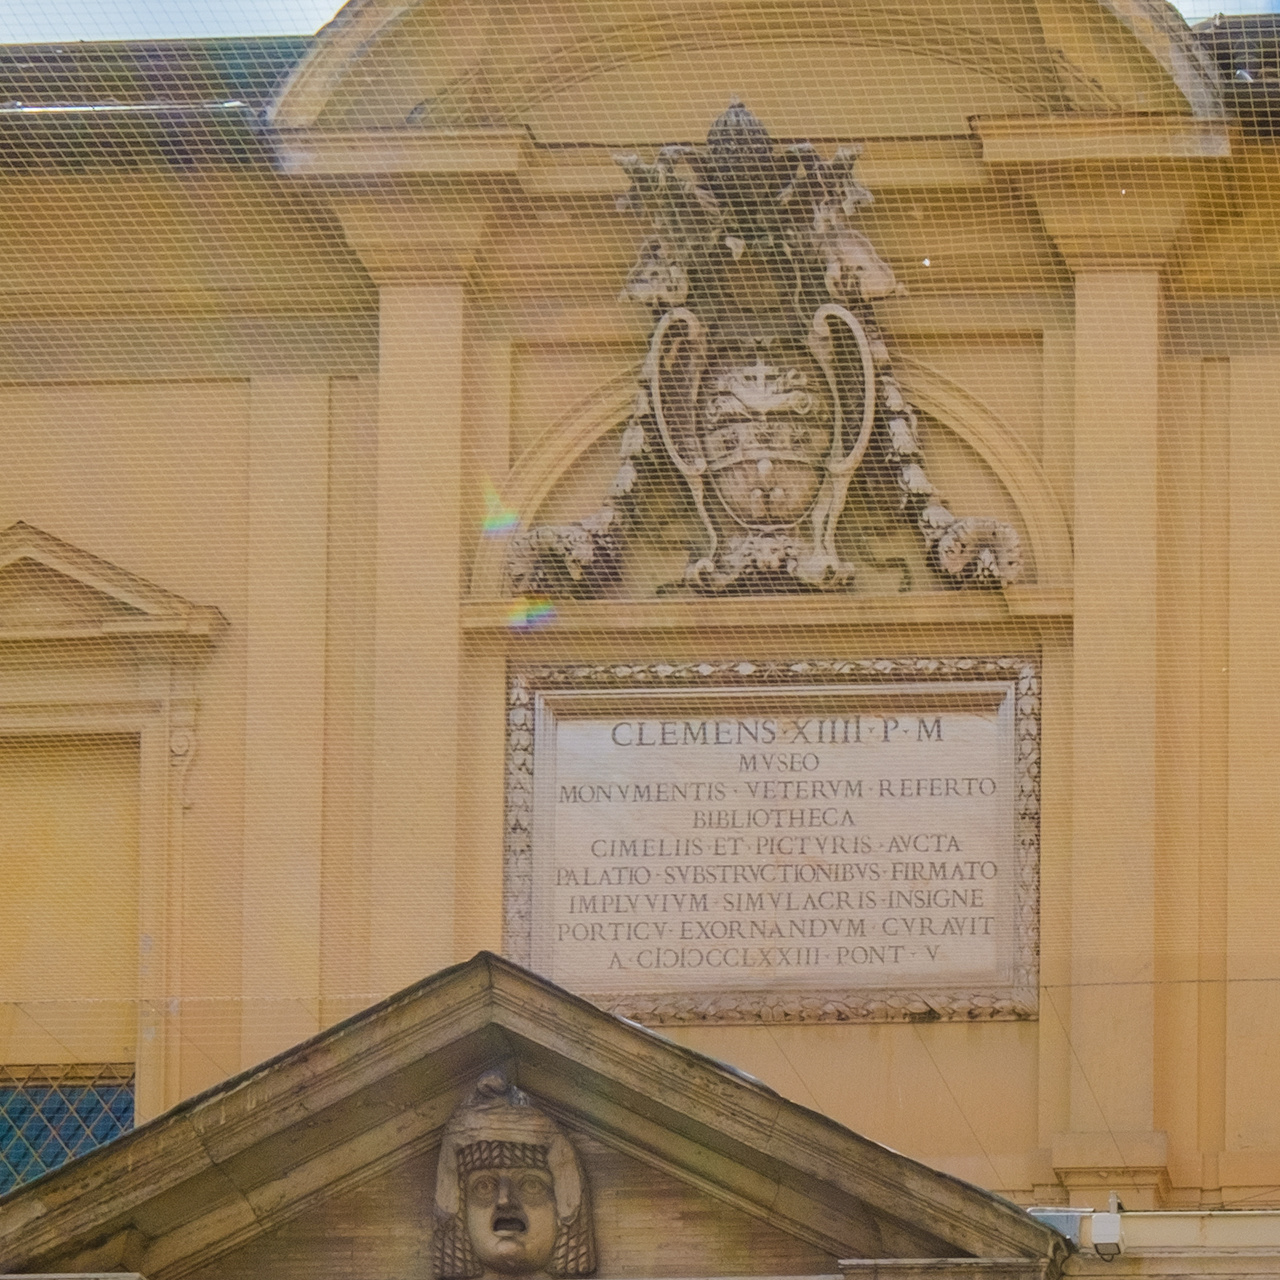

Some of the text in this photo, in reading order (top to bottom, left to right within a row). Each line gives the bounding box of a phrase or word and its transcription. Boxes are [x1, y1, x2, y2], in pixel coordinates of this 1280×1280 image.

[611, 715, 944, 747] CLEMENS XIIII P M
[738, 752, 820, 773] MVSEO
[558, 776, 998, 804] MONVMENTIS VETERVM REFERTO
[692, 806, 856, 829] BIBLIOTHECA
[590, 833, 963, 858] CIMELIIS ET PICTVRIS AVCTA
[555, 860, 998, 886] PALATIO SVBSTRVCTIONIBVS FIRMATO
[569, 888, 985, 914] IMPLVVIVM SIMVLACRIS INSIGNE
[557, 916, 996, 942] PORTICV EXORNANDVM CVRAVIT
[607, 951, 627, 970] A
[836, 945, 906, 966] PONT
[923, 944, 941, 962] V
